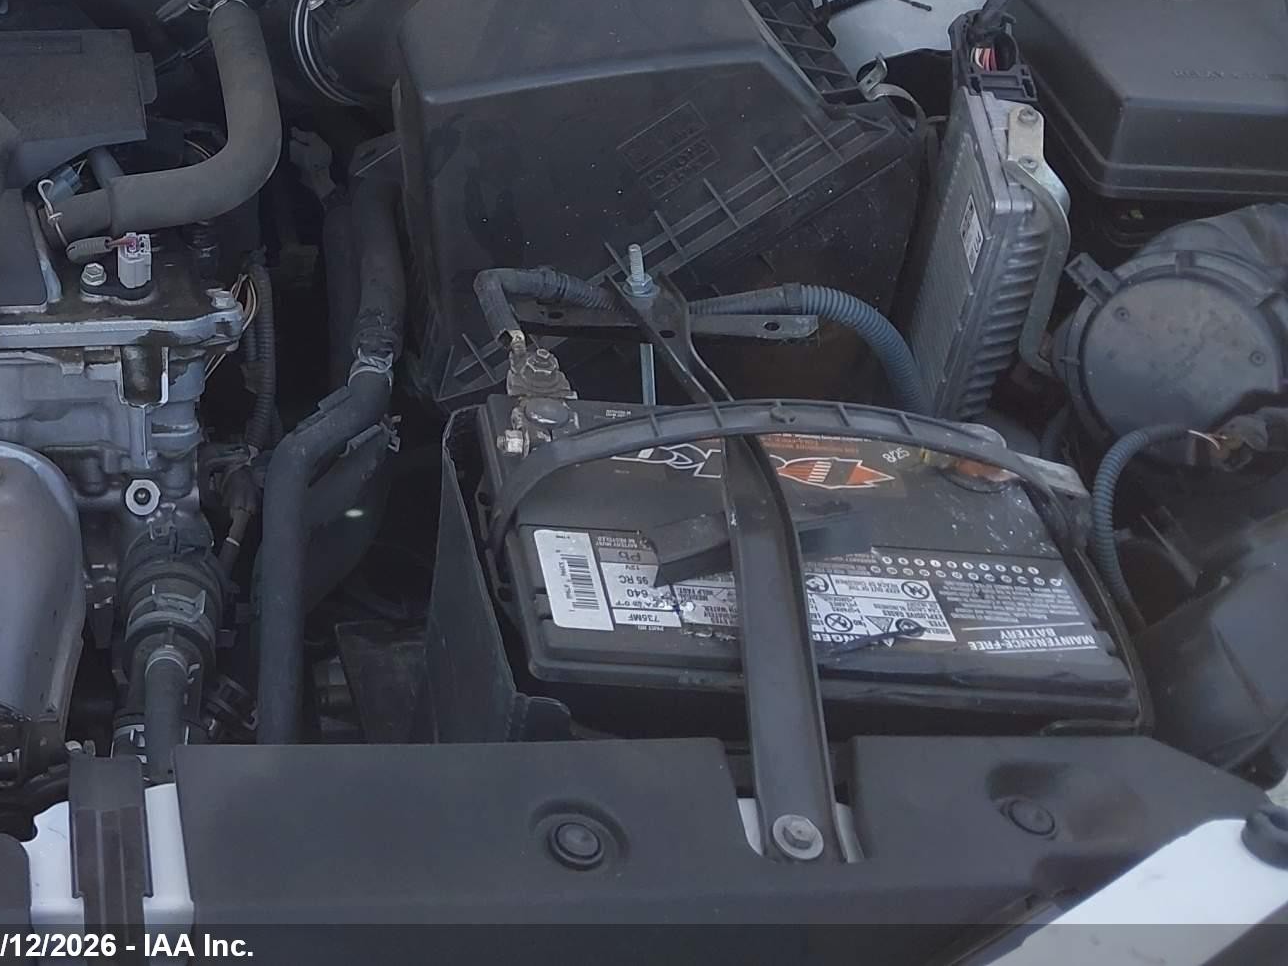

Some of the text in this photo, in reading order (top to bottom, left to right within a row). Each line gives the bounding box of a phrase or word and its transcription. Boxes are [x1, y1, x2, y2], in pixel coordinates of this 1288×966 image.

[618, 551, 641, 562] Pb
[618, 574, 649, 585] 95 RC
[626, 588, 649, 599] 640
[1000, 627, 1057, 640] BATTERY
[968, 635, 1096, 651] MAINTENANCE-FREE
